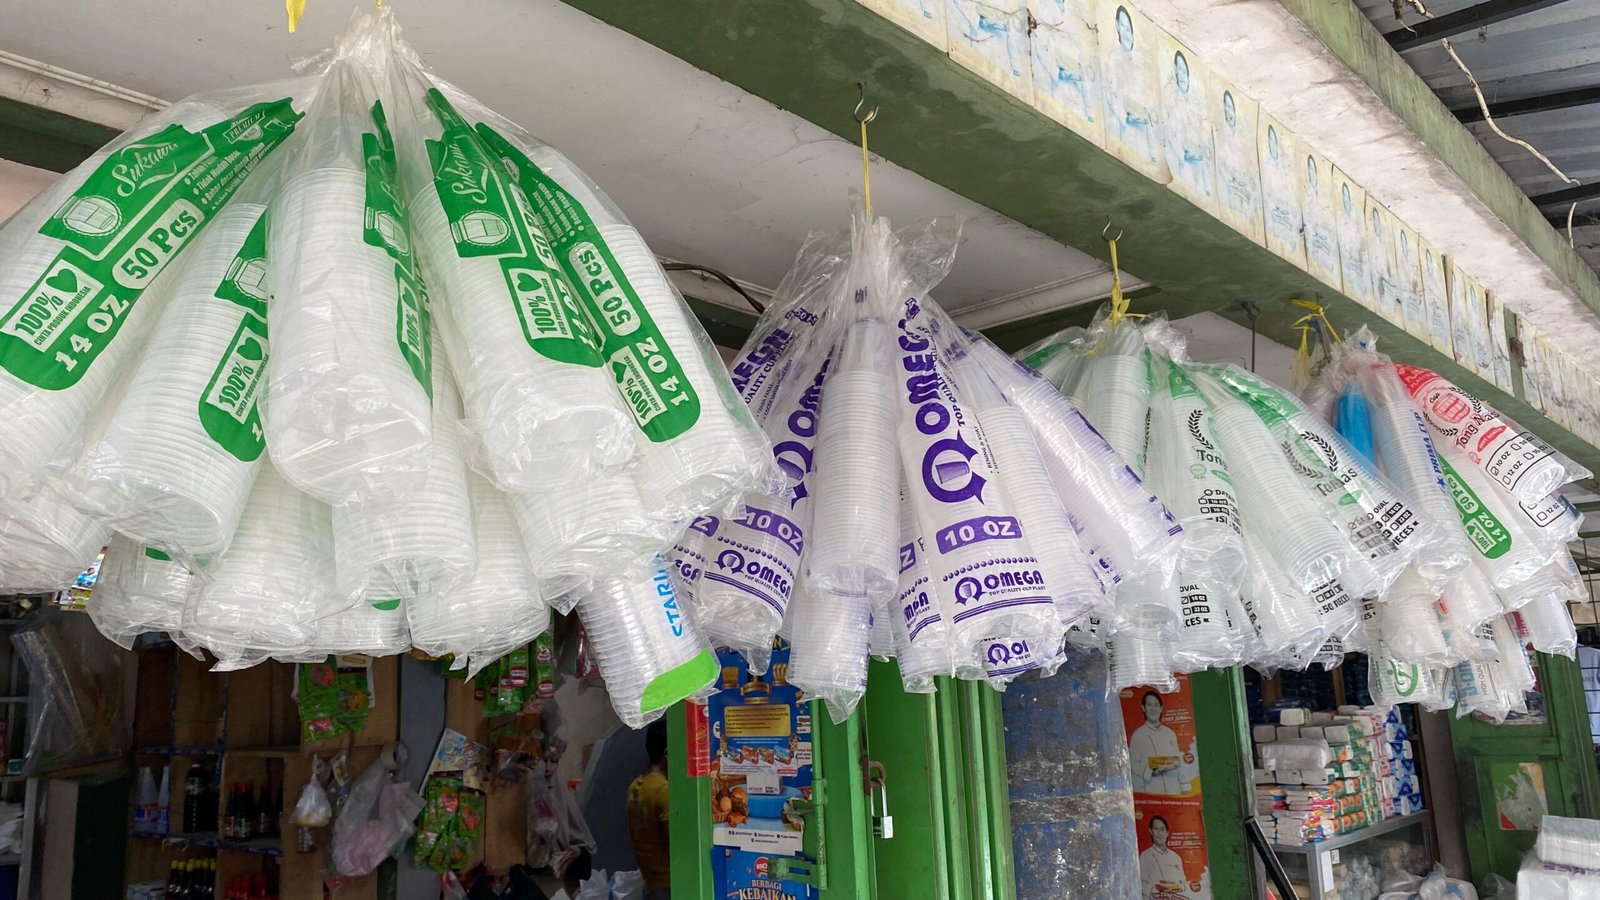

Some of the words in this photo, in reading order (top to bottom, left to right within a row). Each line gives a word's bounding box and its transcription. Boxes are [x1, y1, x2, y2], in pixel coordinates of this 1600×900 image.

[120, 247, 159, 280] 50
[15, 292, 64, 336] 100%
[33, 327, 51, 346] CINTA
[47, 308, 69, 331] PRODUK
[64, 284, 91, 312] INDONESIA
[526, 295, 557, 334] 100%
[602, 296, 631, 327] 50
[55, 333, 93, 372] 14
[87, 294, 129, 333] OZ
[636, 336, 668, 373] OZ
[218, 361, 254, 408] 100%
[625, 377, 652, 420] 100%
[660, 375, 689, 407] 14
[744, 372, 764, 406] UALITY
[953, 403, 965, 427] TOP
[1456, 424, 1479, 449] Tong
[1472, 411, 1500, 425] Nas
[1423, 437, 1441, 473] PRIMA
[1501, 451, 1511, 460] OZ
[1513, 461, 1523, 469] OZ
[1373, 500, 1389, 514] OVAL
[1460, 497, 1474, 510] 50
[746, 511, 771, 528] 10
[778, 523, 802, 550] OZ
[945, 525, 975, 546] 10
[983, 520, 1016, 536] OZ
[1478, 512, 1494, 528] OZ
[1492, 528, 1507, 541] 14
[1475, 532, 1490, 550] 100%
[747, 562, 790, 600] OMEGA
[984, 570, 1044, 589] OMEGA
[751, 880, 782, 890] BERBAGI
